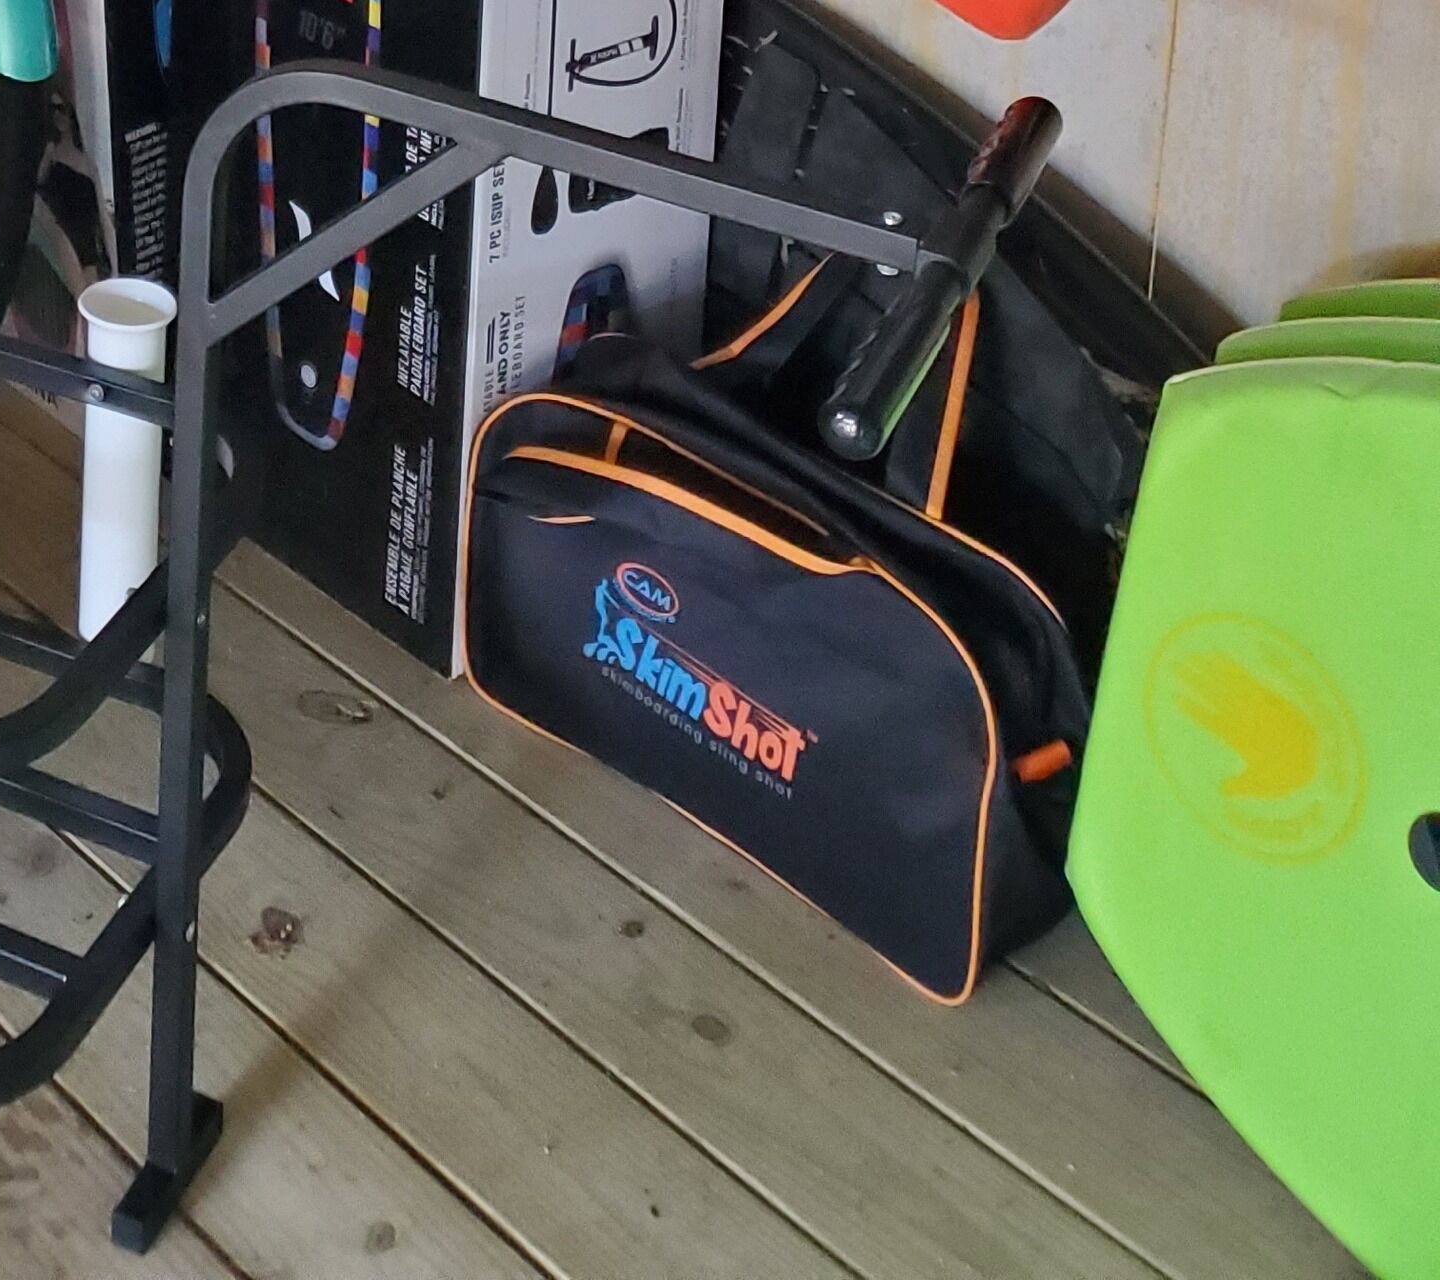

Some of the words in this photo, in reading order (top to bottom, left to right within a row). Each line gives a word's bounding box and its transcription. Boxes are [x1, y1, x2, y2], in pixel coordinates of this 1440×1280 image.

[491, 192, 503, 226] ISUP
[489, 229, 502, 250] PC
[489, 255, 500, 264] 7
[414, 264, 427, 294] SET
[515, 296, 525, 318] SET
[397, 305, 412, 389] INFLATABLE
[410, 295, 427, 397] PADDLEBOARD
[498, 311, 511, 356] ONLY
[497, 358, 509, 395] AND
[510, 321, 524, 394] LEBOARD
[391, 442, 407, 509] PLANCHE
[390, 504, 402, 531] DE
[402, 469, 419, 550] GONFLABLE
[384, 531, 401, 606] ENSEMBLE
[399, 551, 413, 602] PAGAIE
[623, 570, 671, 611] CAM
[601, 666, 703, 744] skimboarding
[710, 739, 748, 775] sling
[755, 769, 792, 801] shot
